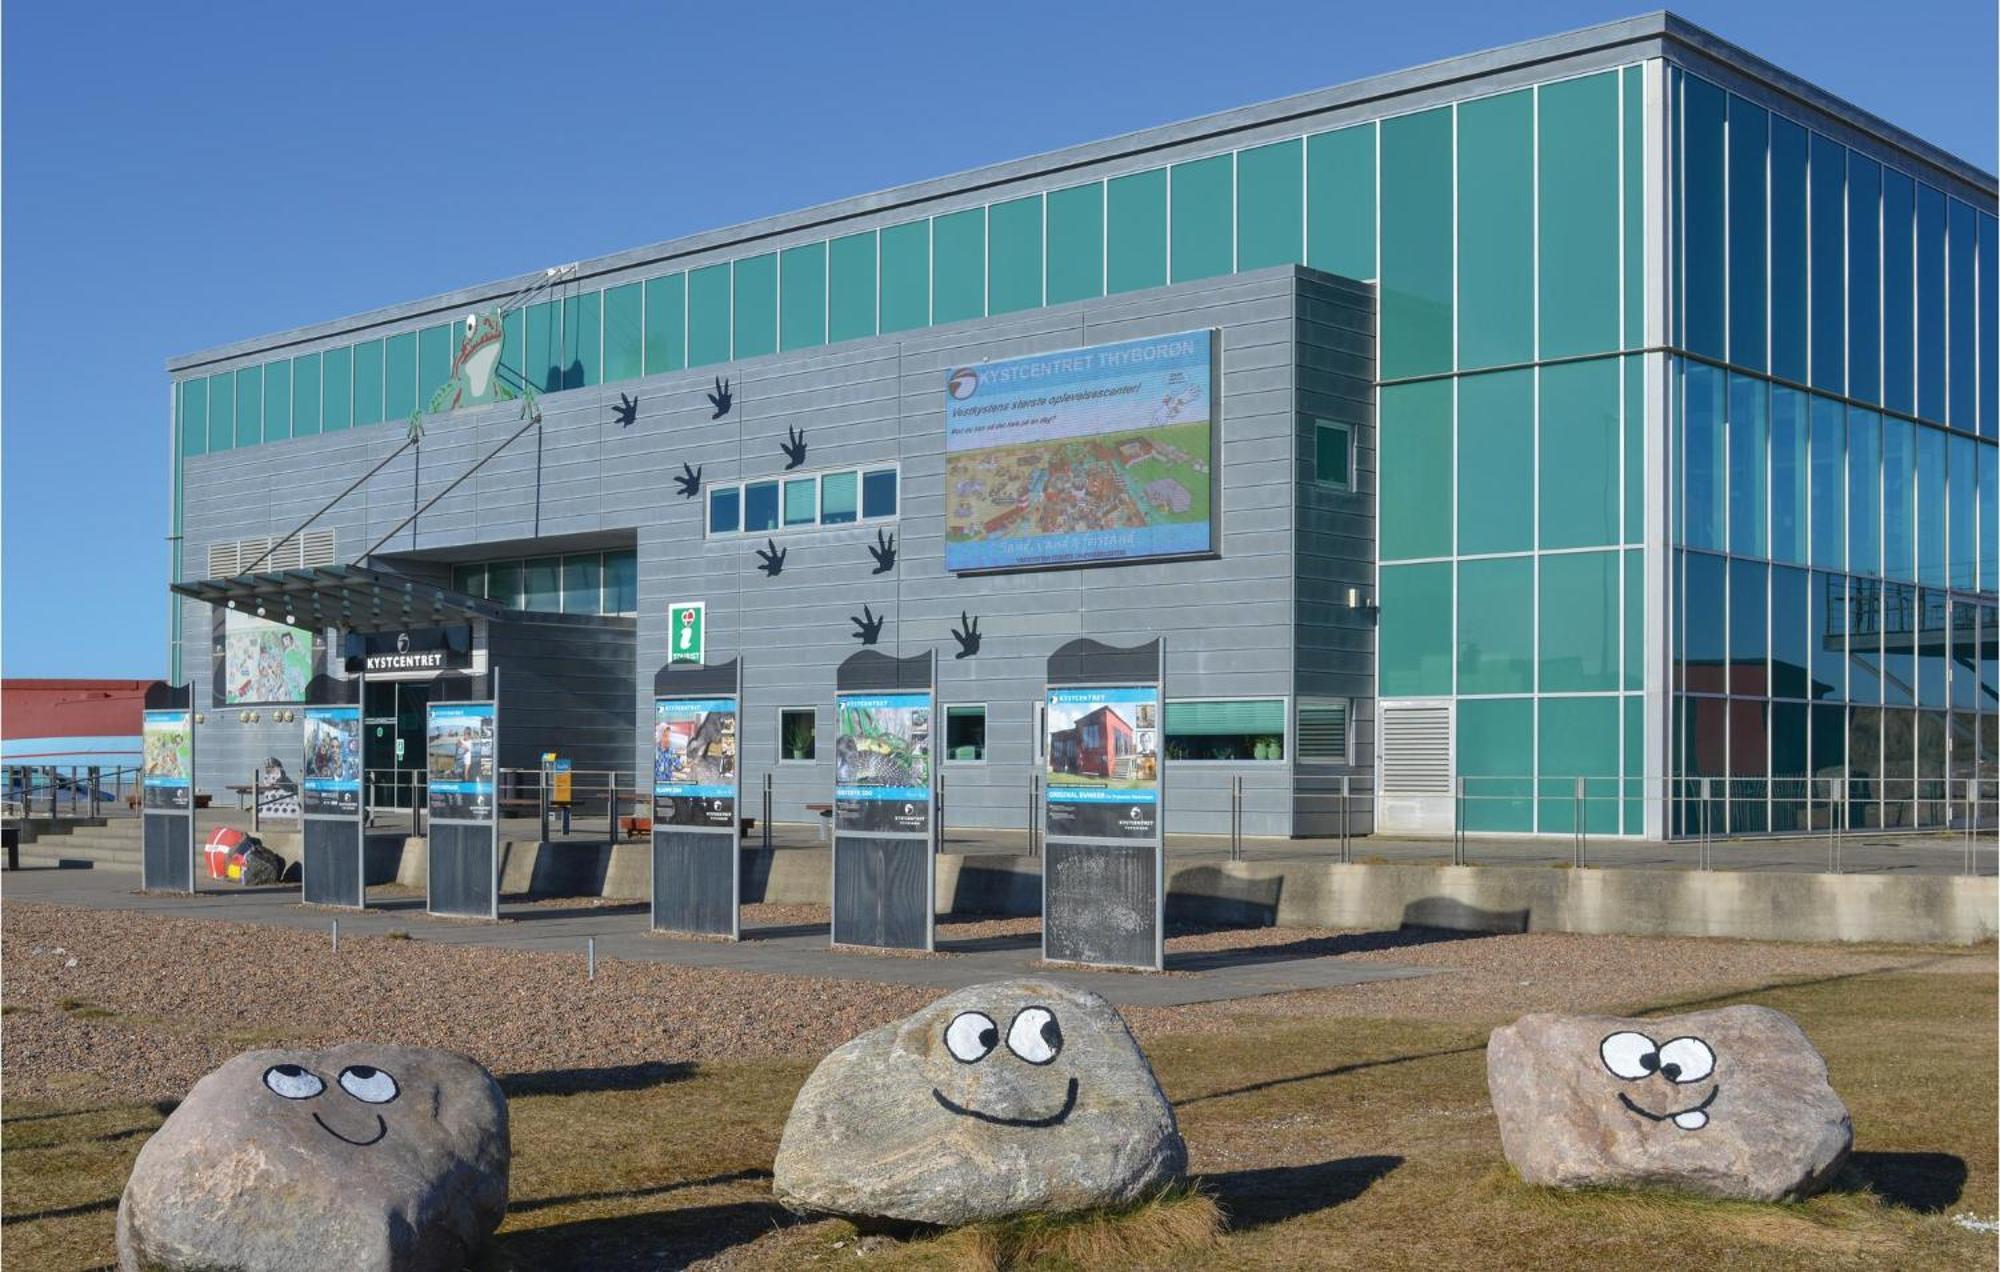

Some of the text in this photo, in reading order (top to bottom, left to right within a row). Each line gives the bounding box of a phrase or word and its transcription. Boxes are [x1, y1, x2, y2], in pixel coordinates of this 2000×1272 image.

[980, 340, 1195, 385] KYSTCENTRET THYBORØN
[953, 401, 1009, 417] Vestkystens
[367, 654, 442, 669] KYSTCENTRET
